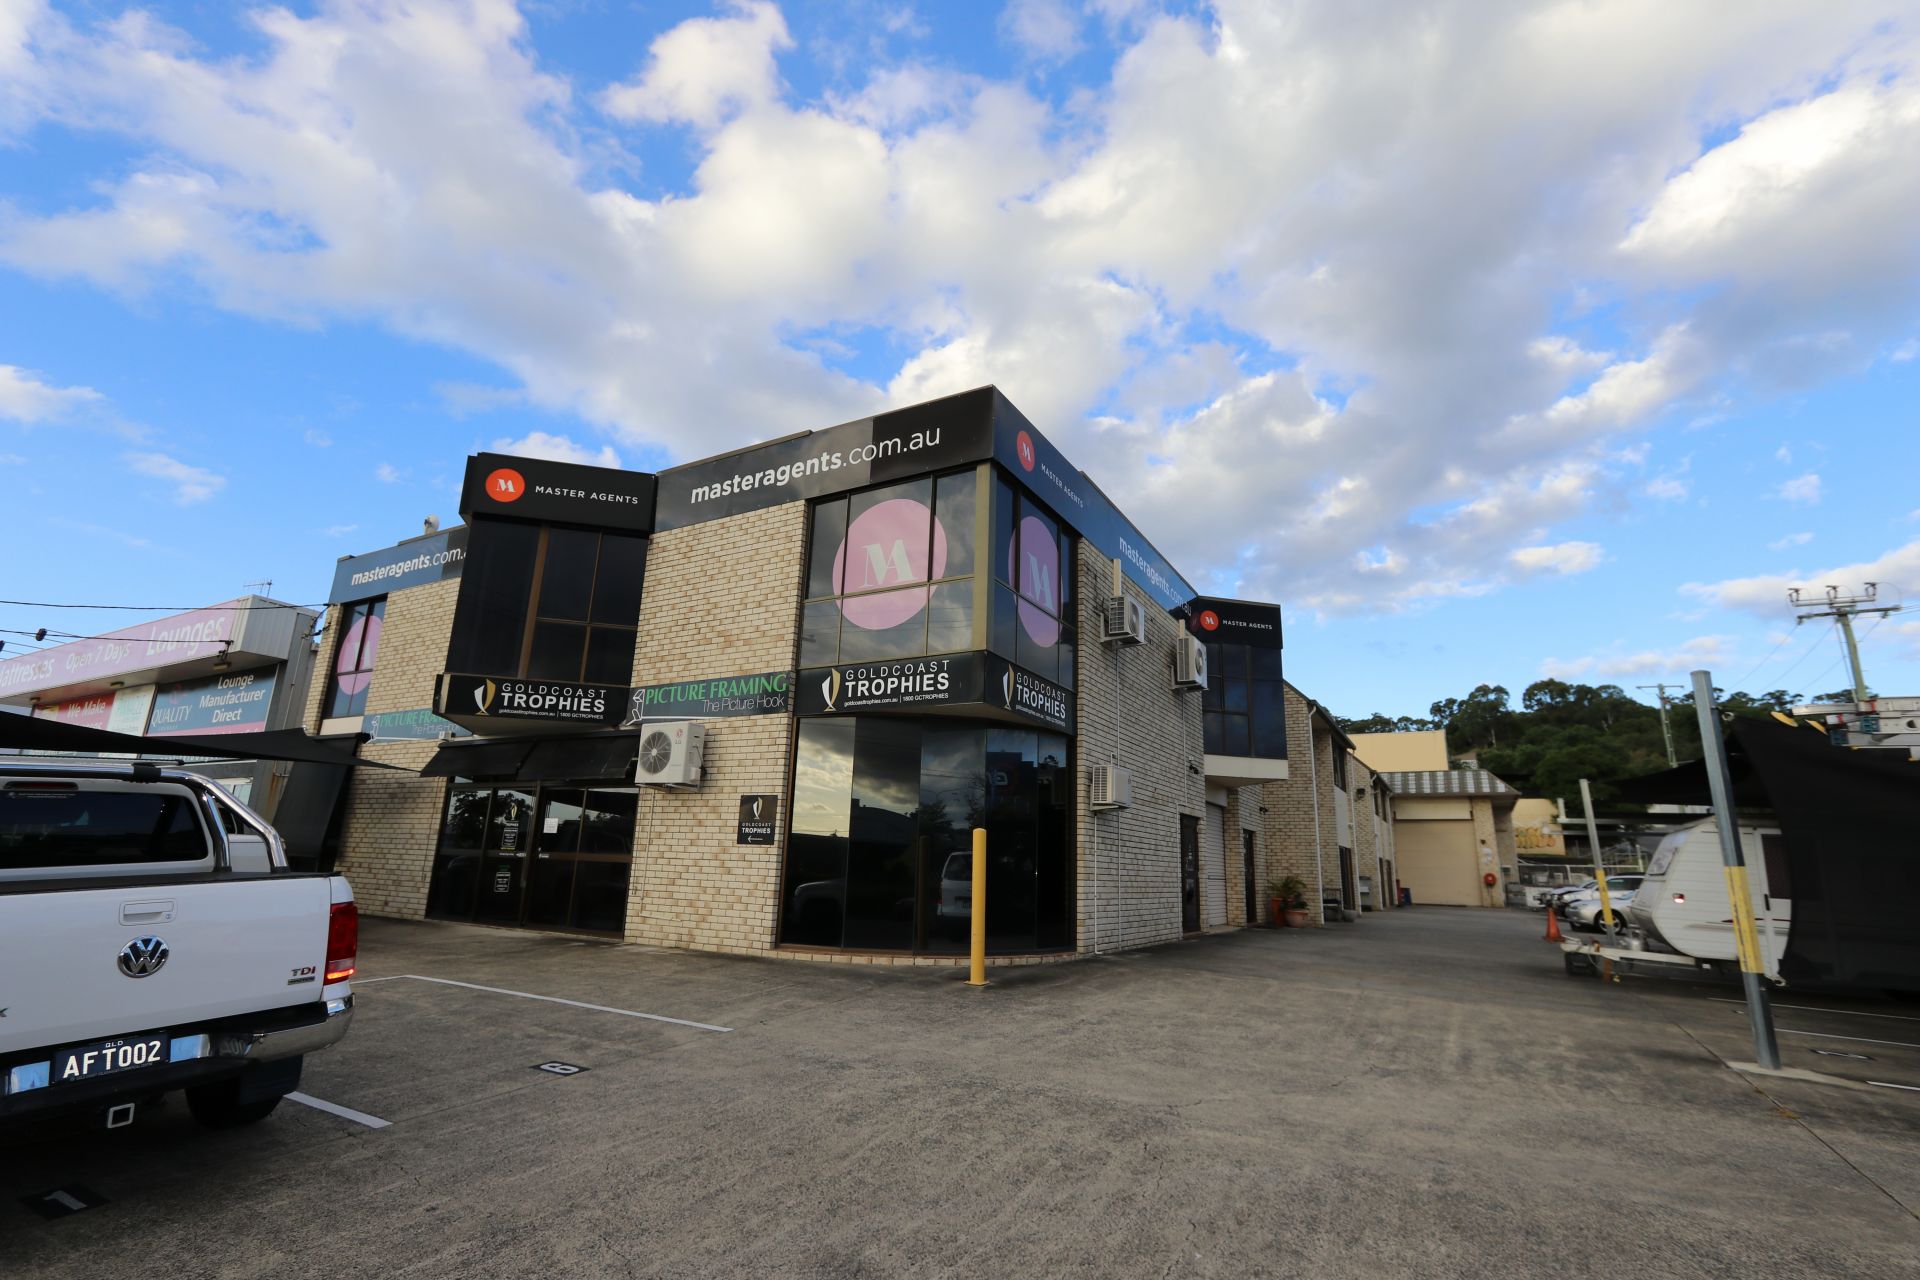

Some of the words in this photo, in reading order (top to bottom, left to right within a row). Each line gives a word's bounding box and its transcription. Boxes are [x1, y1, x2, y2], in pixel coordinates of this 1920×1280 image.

[691, 427, 941, 504] masteragents.com.au
[535, 485, 585, 498] MASTER
[590, 492, 639, 504] AGENTS
[1041, 463, 1063, 488] MASTER
[1064, 485, 1084, 508] AGENTS
[1222, 619, 1247, 627] MASTER
[1248, 622, 1273, 630] AGENTS
[145, 615, 227, 657] Lounges
[65, 651, 92, 674] Open
[96, 646, 103, 664] 7
[105, 643, 130, 664] Days
[0, 658, 56, 688] attresses
[845, 660, 950, 680] GOLDCOAST
[217, 673, 254, 690] Lounge
[502, 683, 607, 698] GOLDCOAST
[645, 682, 707, 705] PICTURE
[709, 674, 787, 699] FRAMING
[845, 672, 950, 698] TROPHIES
[1016, 672, 1066, 702] GOLDCOAST
[67, 703, 82, 718] We
[82, 698, 106, 716] Make
[199, 688, 266, 708] Manufacturer
[501, 692, 605, 713] TROPHIES
[702, 699, 720, 713] The
[722, 696, 755, 712] Picture
[756, 694, 785, 708] Hook
[1016, 684, 1066, 719] TROPHIES
[151, 704, 193, 727] QUALITY
[212, 708, 242, 723] Direct
[380, 711, 418, 727] PICTURE
[291, 966, 316, 976] TDI
[105, 1040, 124, 1048] QLD
[63, 1040, 161, 1079] AFT002
